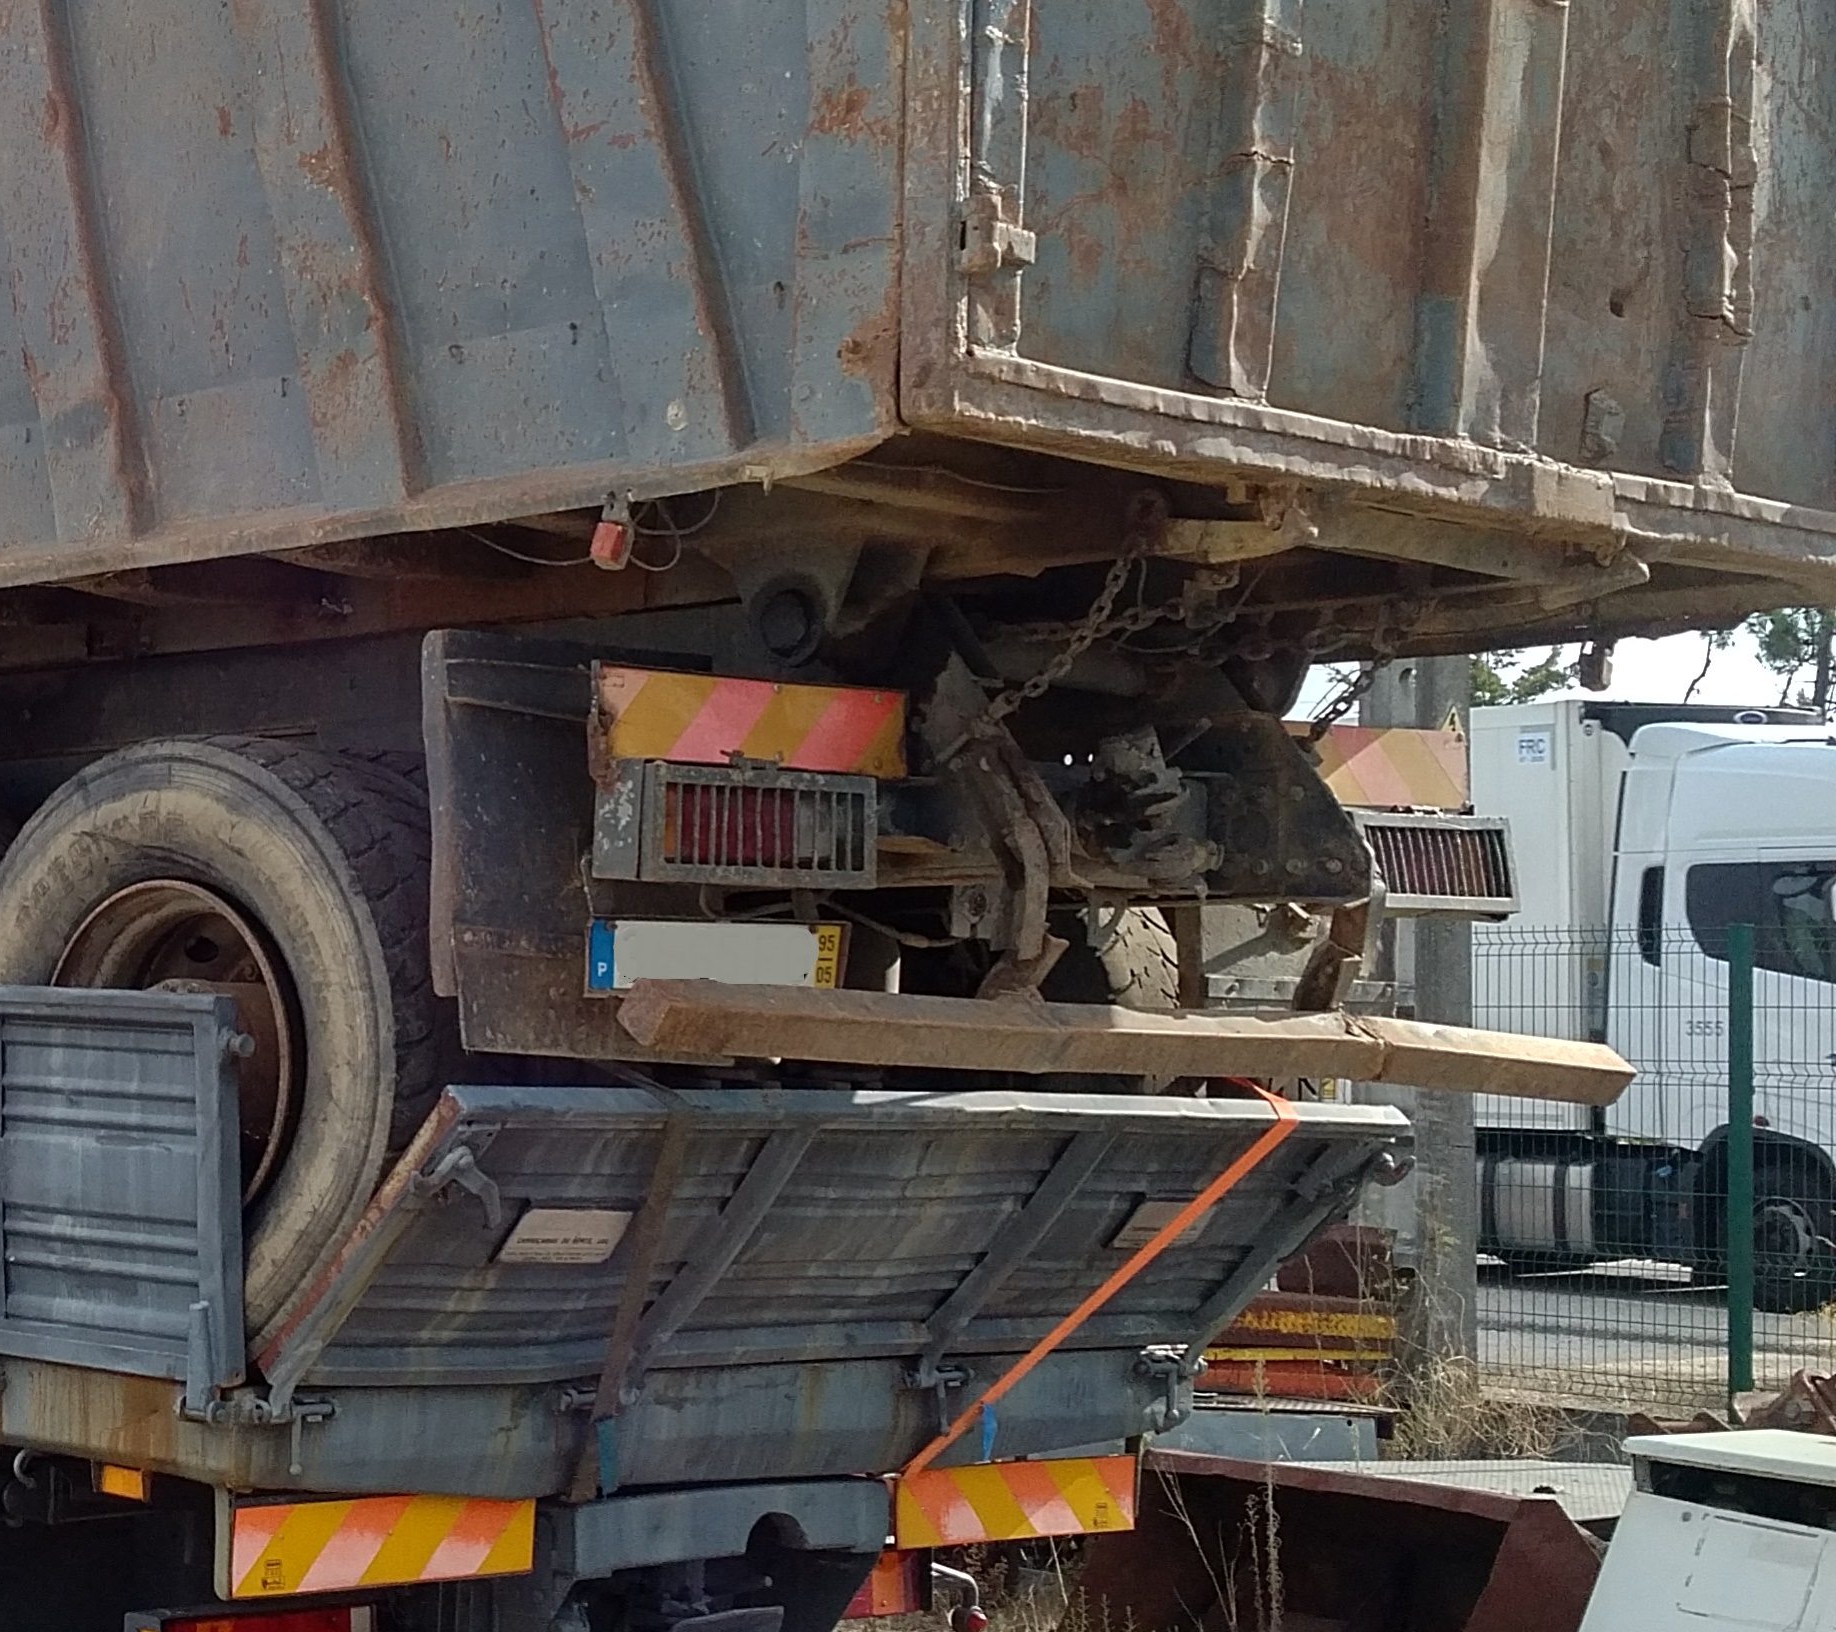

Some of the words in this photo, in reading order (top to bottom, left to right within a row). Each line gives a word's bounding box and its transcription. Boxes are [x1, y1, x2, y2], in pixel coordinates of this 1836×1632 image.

[1518, 738, 1546, 755] FRC
[818, 933, 835, 952] 95
[597, 961, 608, 978] P
[816, 966, 832, 984] 05
